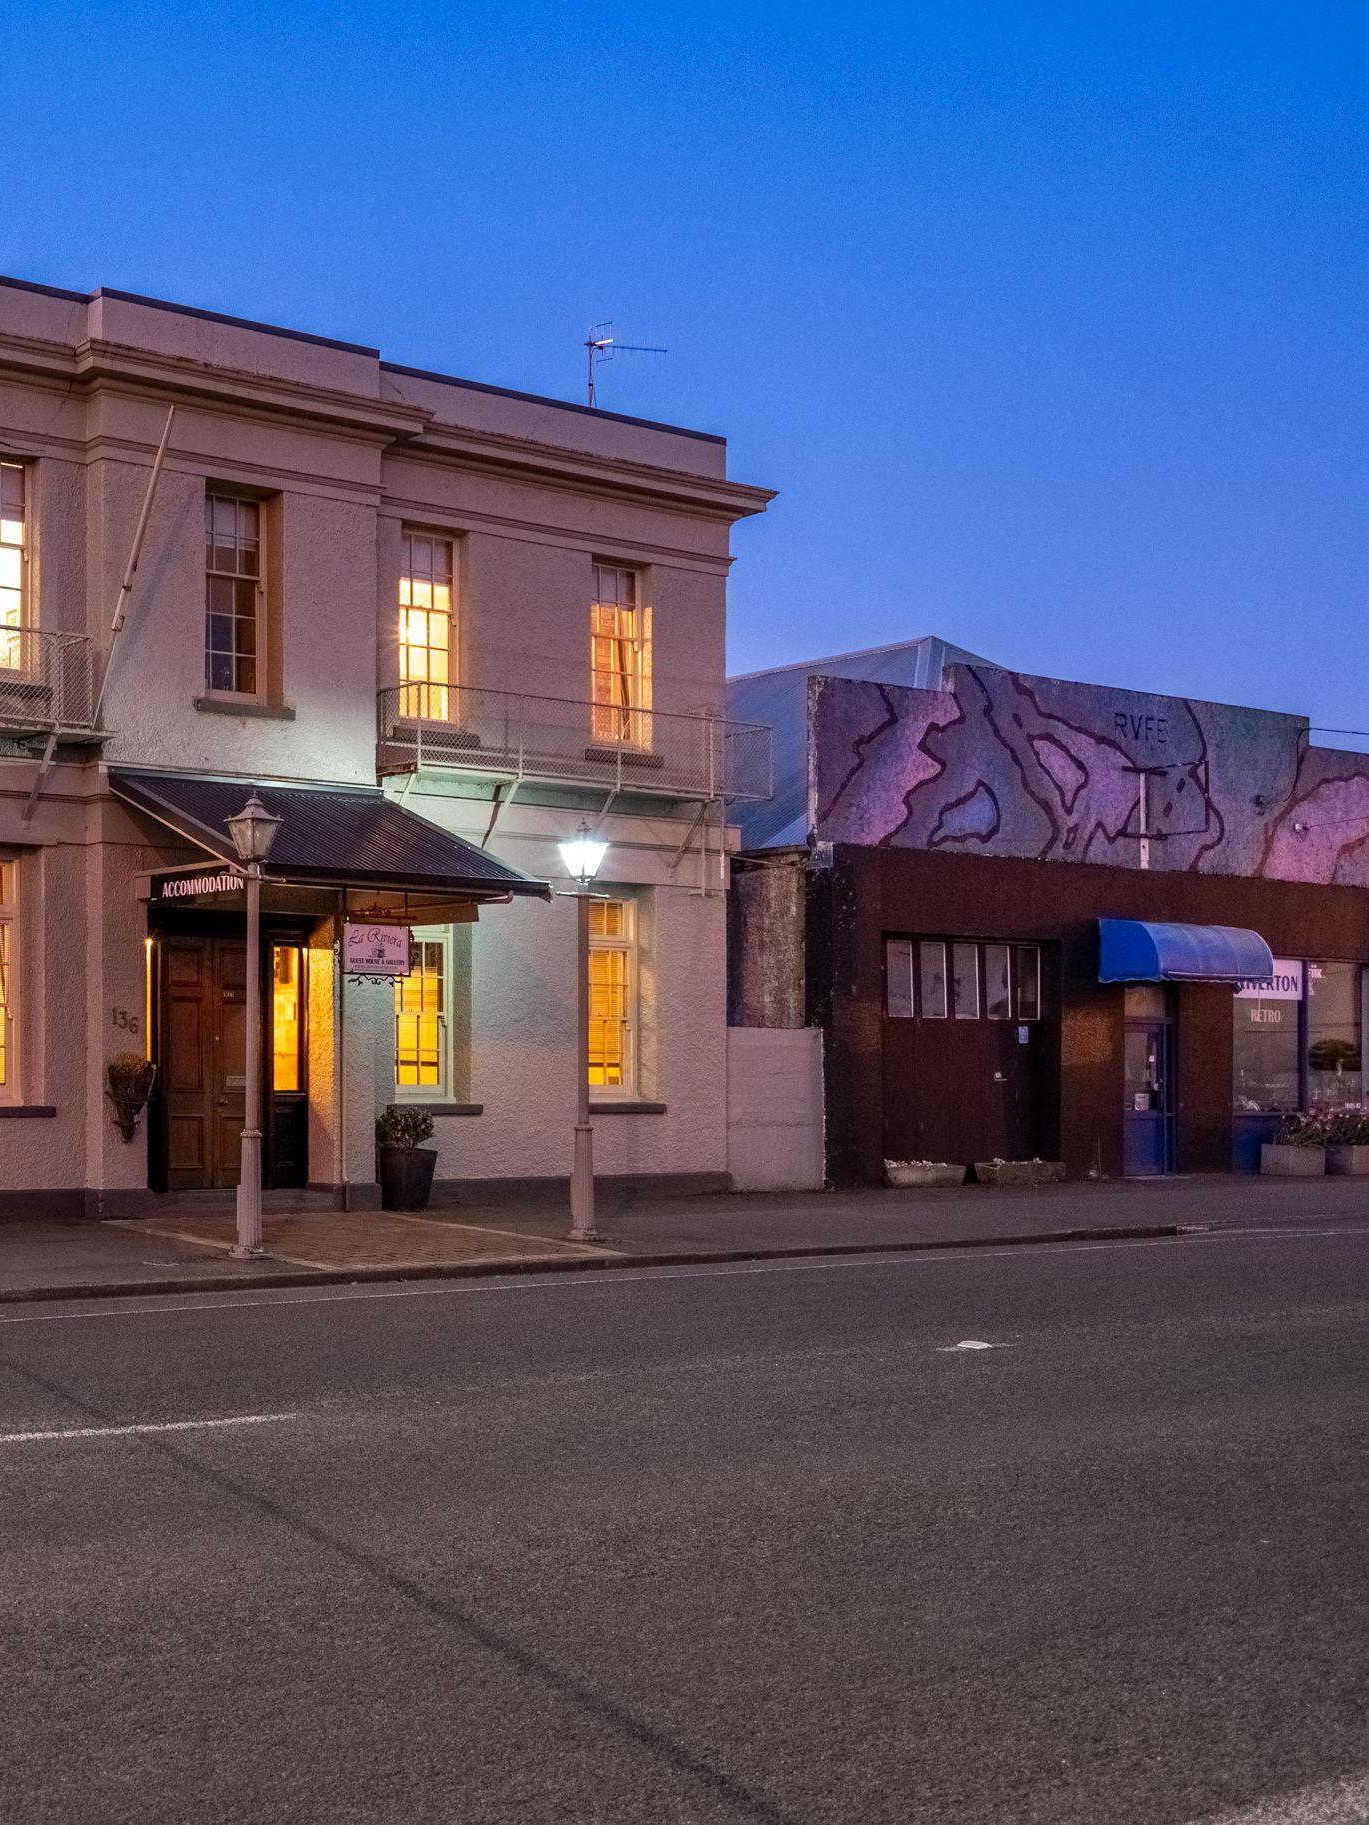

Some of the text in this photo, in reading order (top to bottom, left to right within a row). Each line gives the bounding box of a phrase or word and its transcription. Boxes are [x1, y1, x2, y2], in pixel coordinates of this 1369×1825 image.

[162, 876, 244, 898] ACCOMMODATION
[348, 927, 402, 948] La Riviera
[111, 1007, 139, 1034] 136
[1251, 1009, 1281, 1023] RETRO
